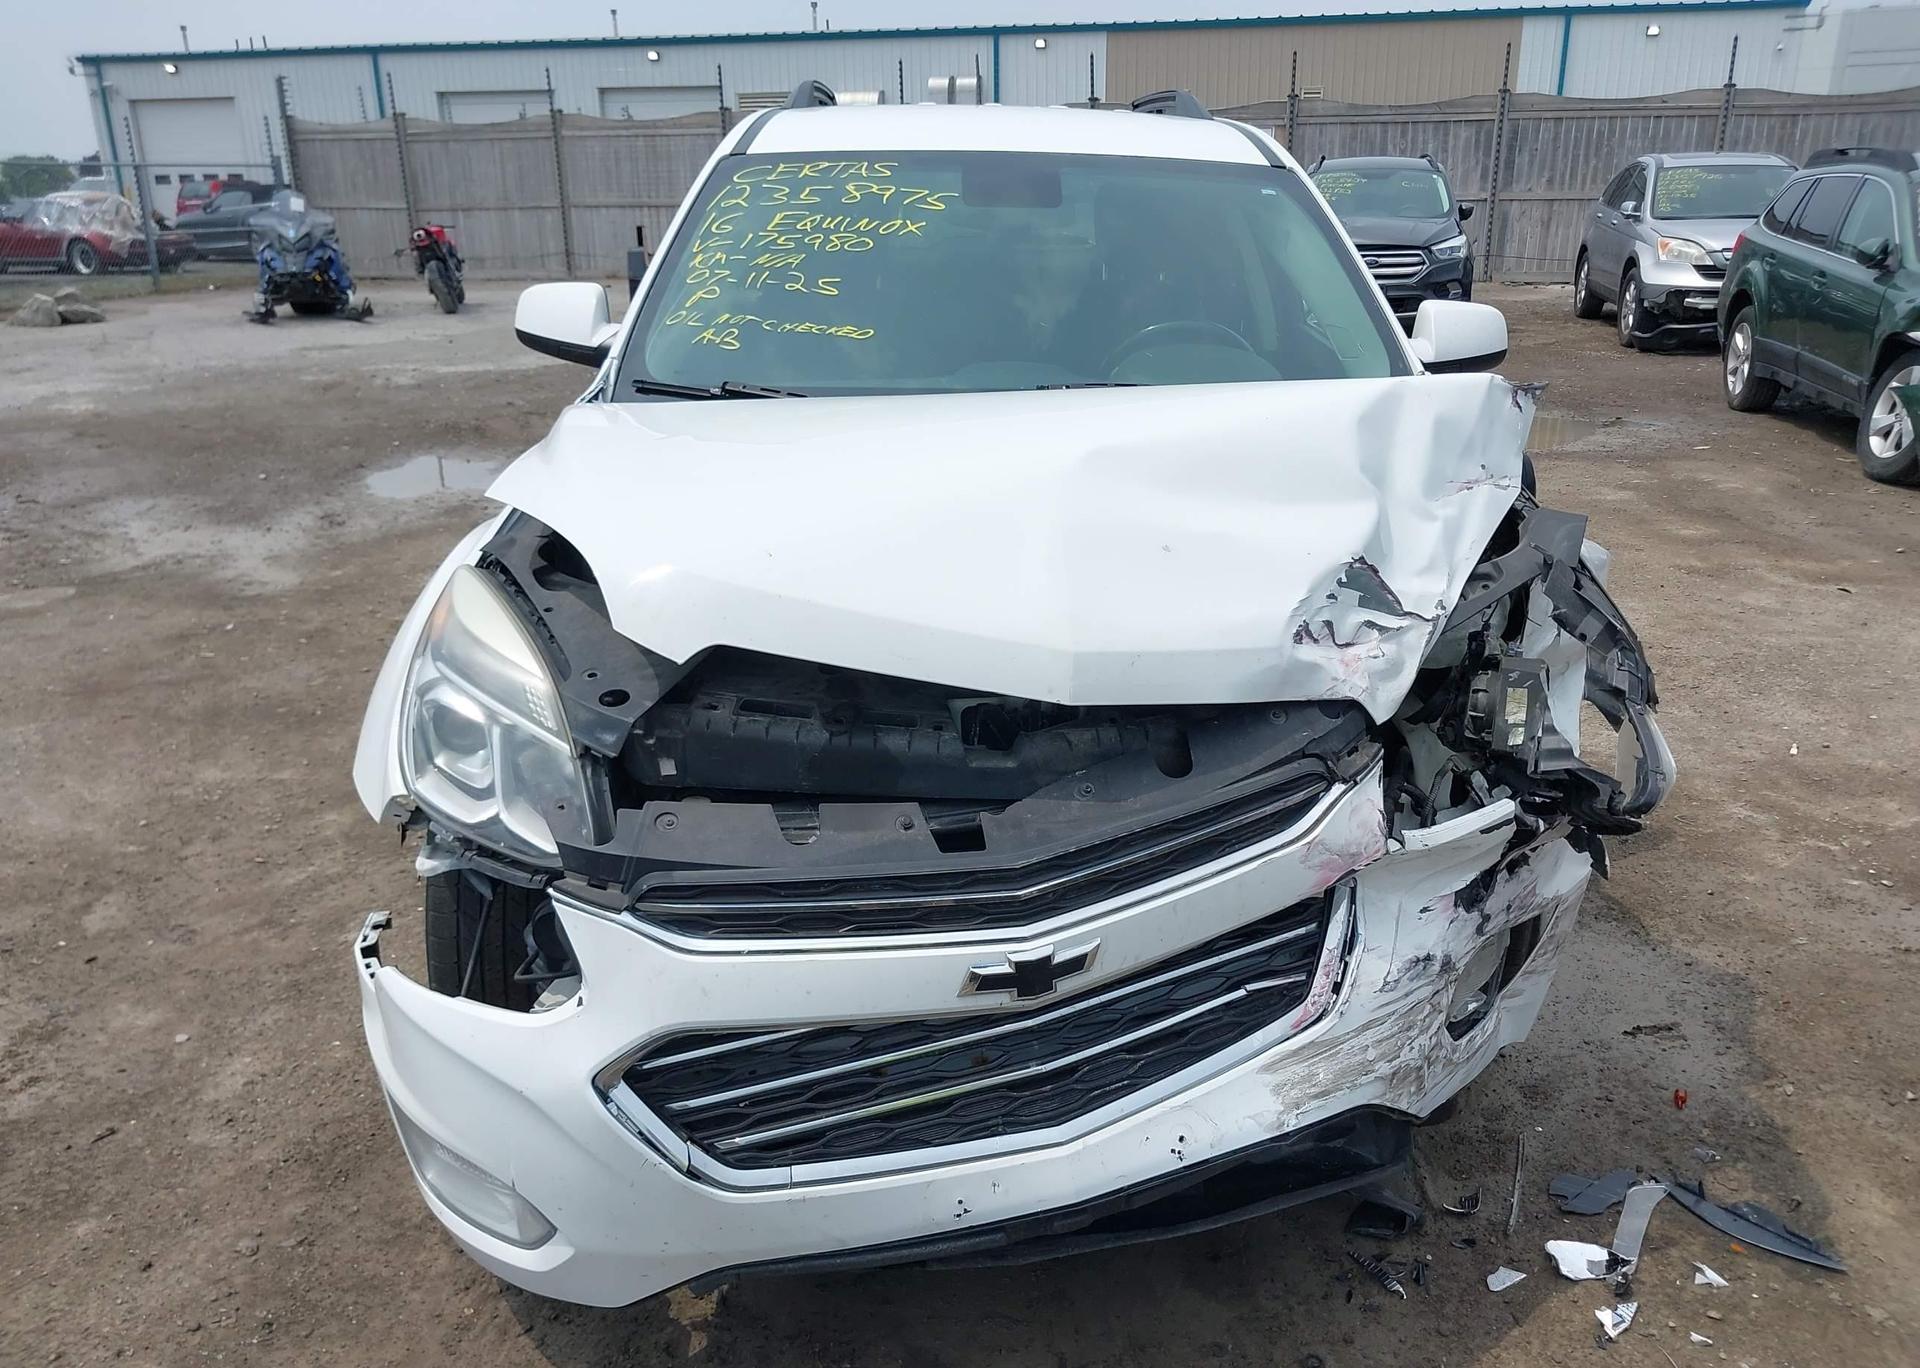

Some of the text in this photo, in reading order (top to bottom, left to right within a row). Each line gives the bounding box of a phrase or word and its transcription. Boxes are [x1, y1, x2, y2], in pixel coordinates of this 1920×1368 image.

[733, 162, 898, 183] CERTAS
[767, 211, 927, 237] EQUINOX
[666, 311, 875, 340] OIL NOT CHECKED
[691, 327, 741, 350] AB
